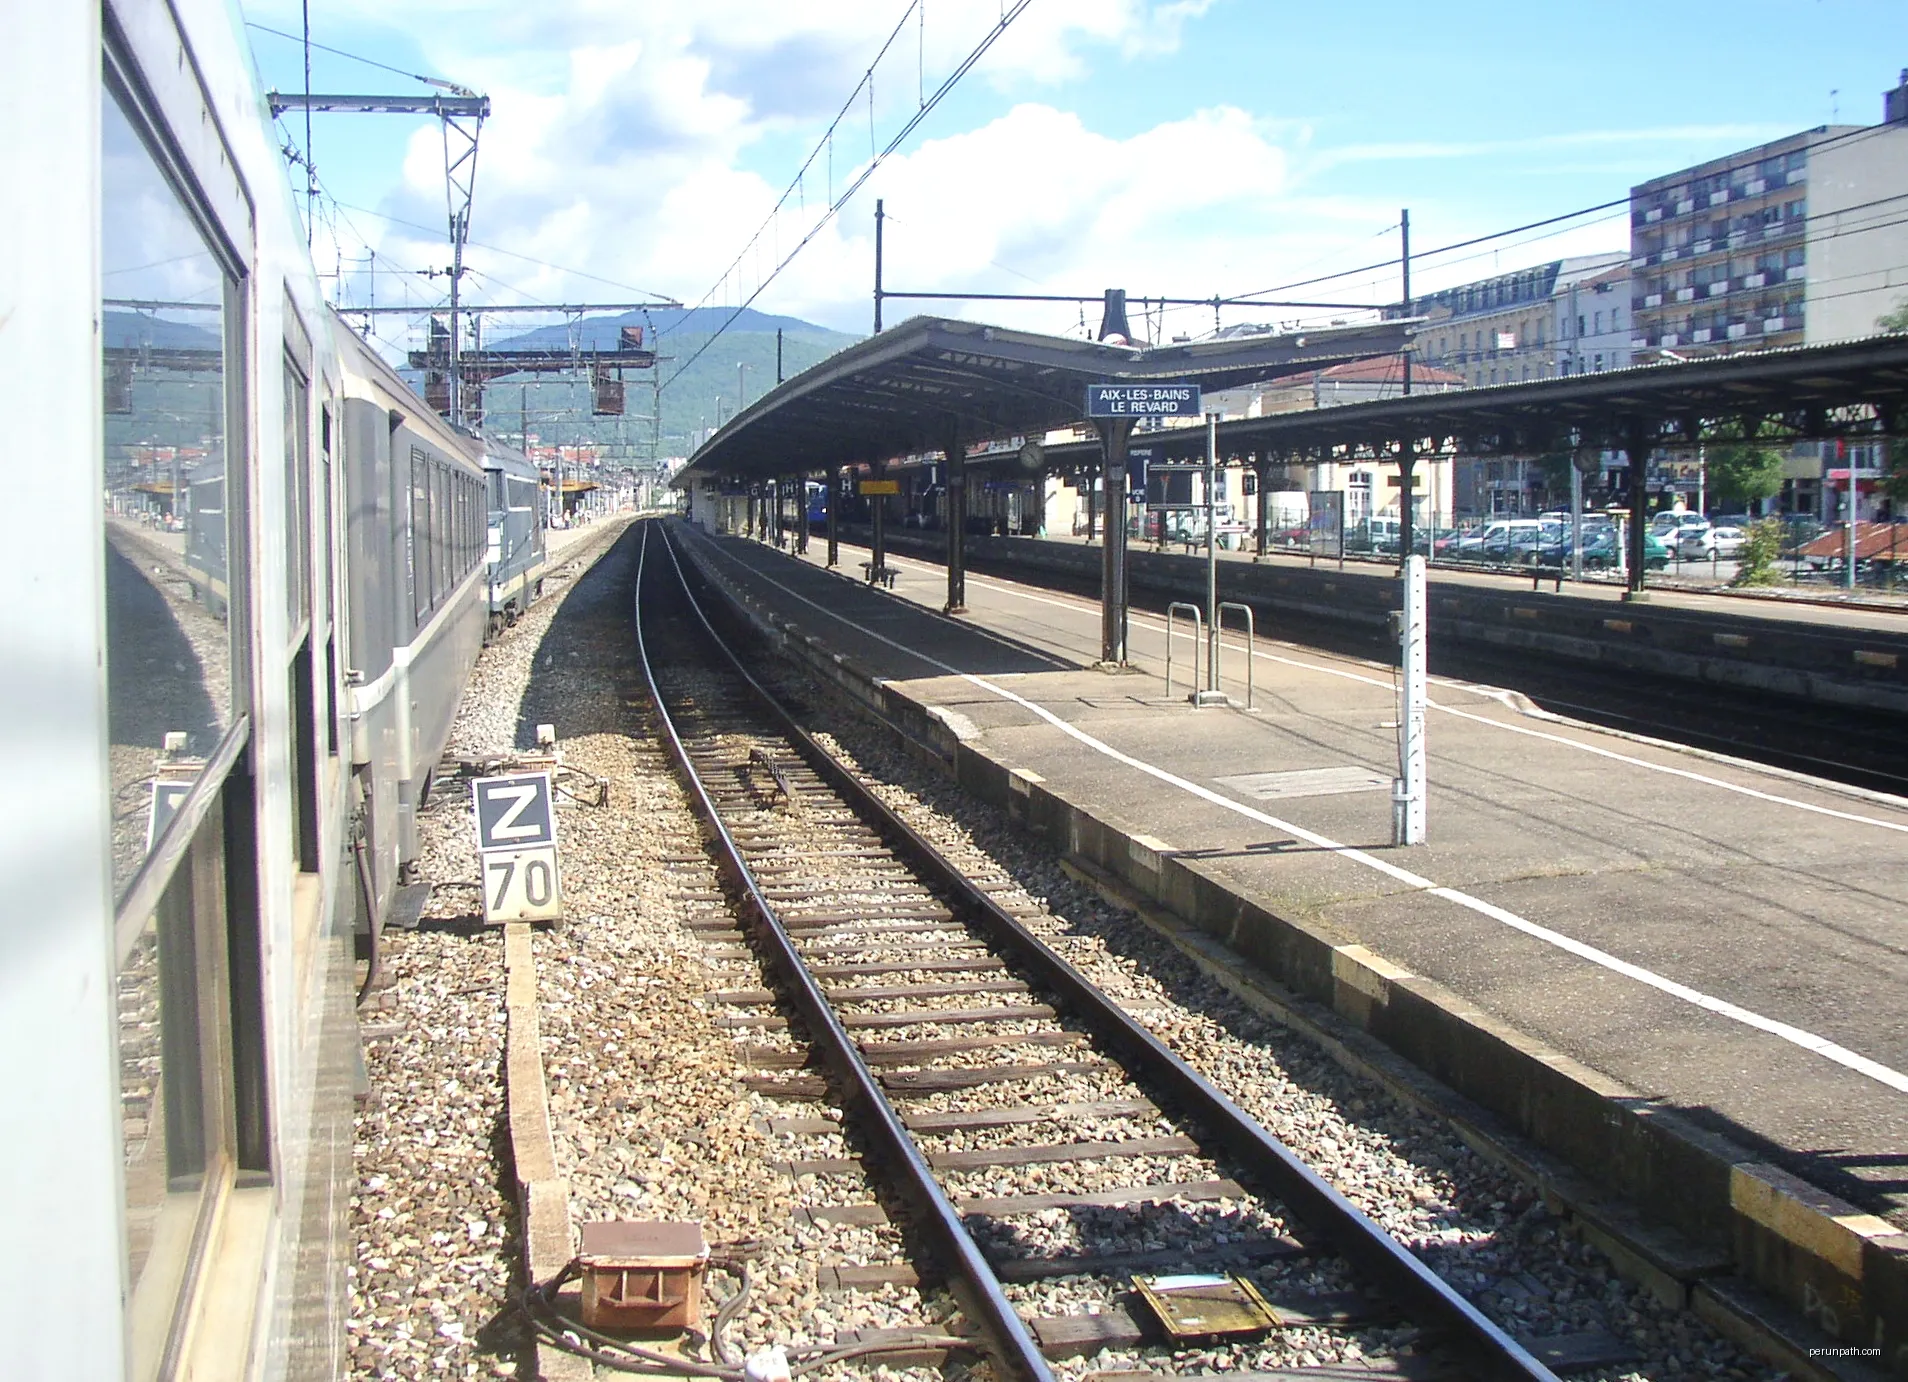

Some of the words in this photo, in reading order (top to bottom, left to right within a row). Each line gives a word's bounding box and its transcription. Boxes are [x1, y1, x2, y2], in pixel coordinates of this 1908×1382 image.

[1099, 389, 1190, 401] AIX-LES-BAINS
[1111, 401, 1126, 413] LE
[1131, 401, 1179, 413] REVARD
[487, 784, 541, 840] Z
[489, 859, 553, 911] 70
